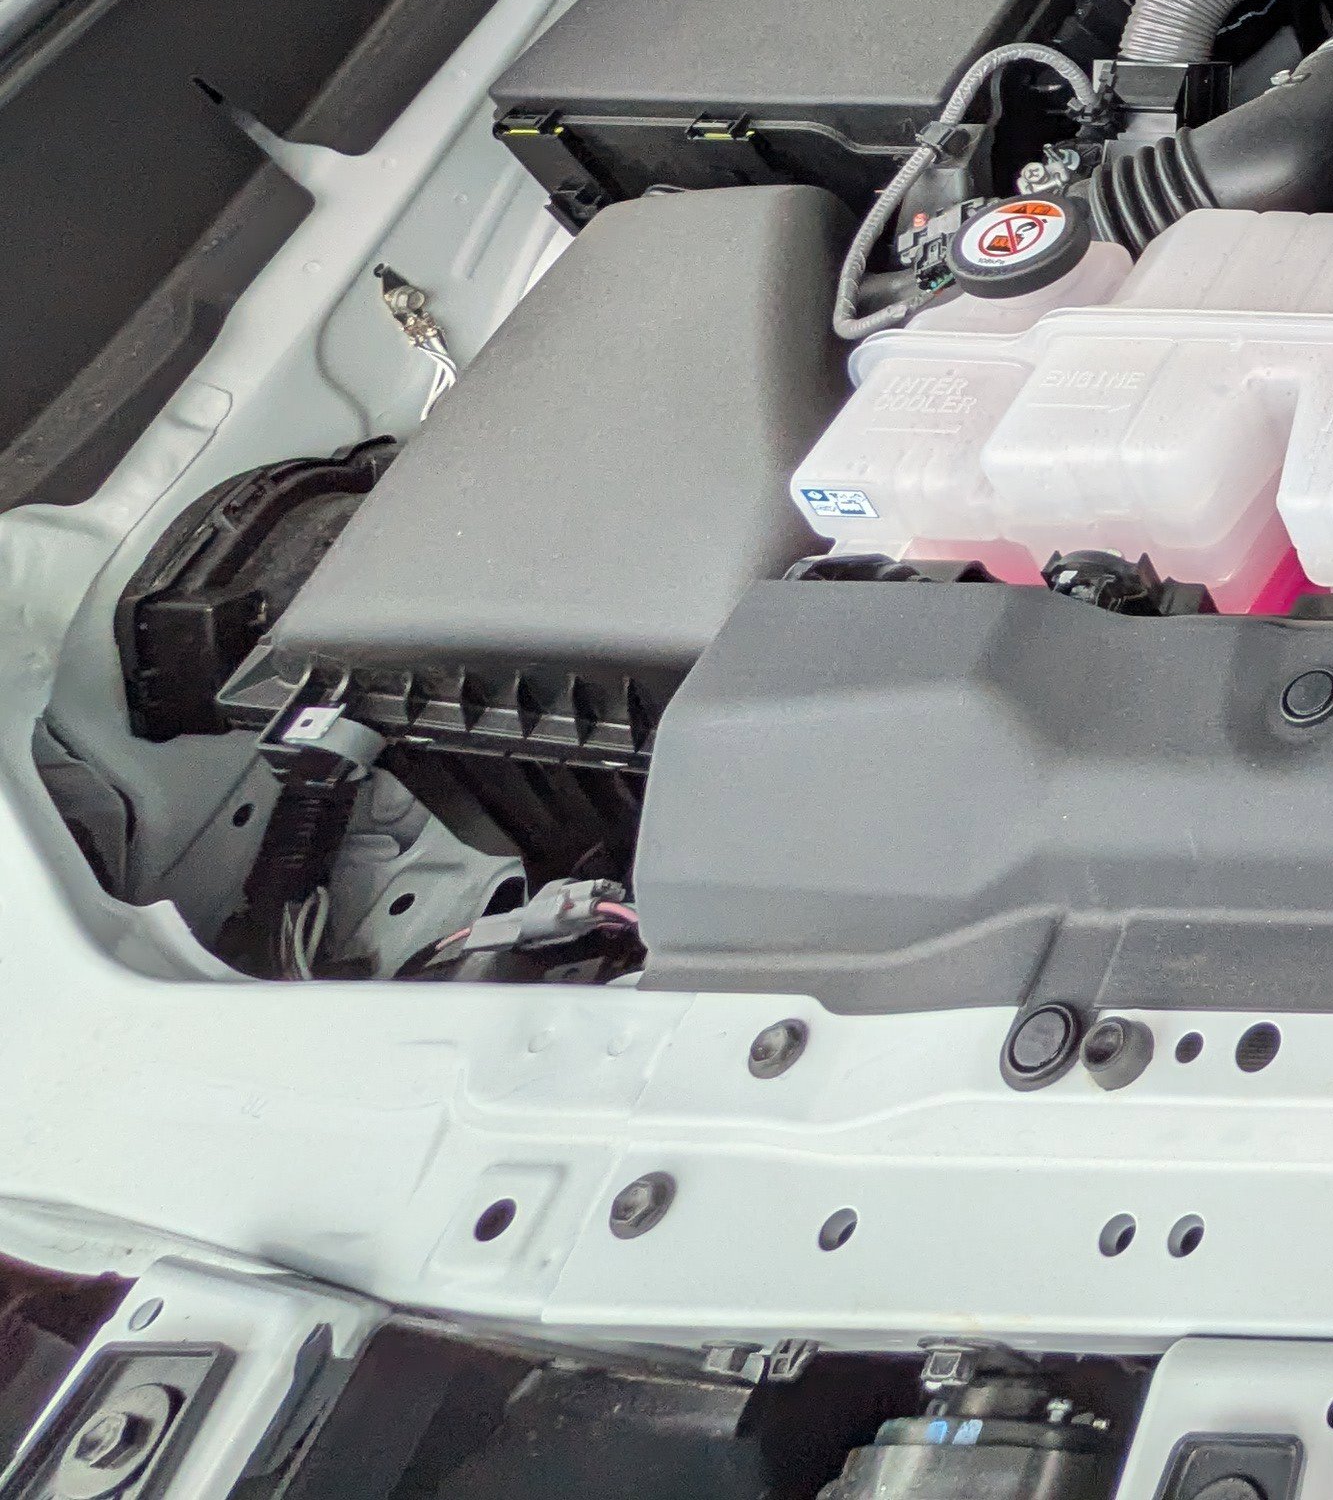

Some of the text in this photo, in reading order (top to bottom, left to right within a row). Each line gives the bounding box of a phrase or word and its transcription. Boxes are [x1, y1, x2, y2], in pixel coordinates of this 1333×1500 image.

[882, 375, 970, 396] INTER
[1041, 369, 1147, 390] ENGINE
[873, 392, 978, 415] COOLER
